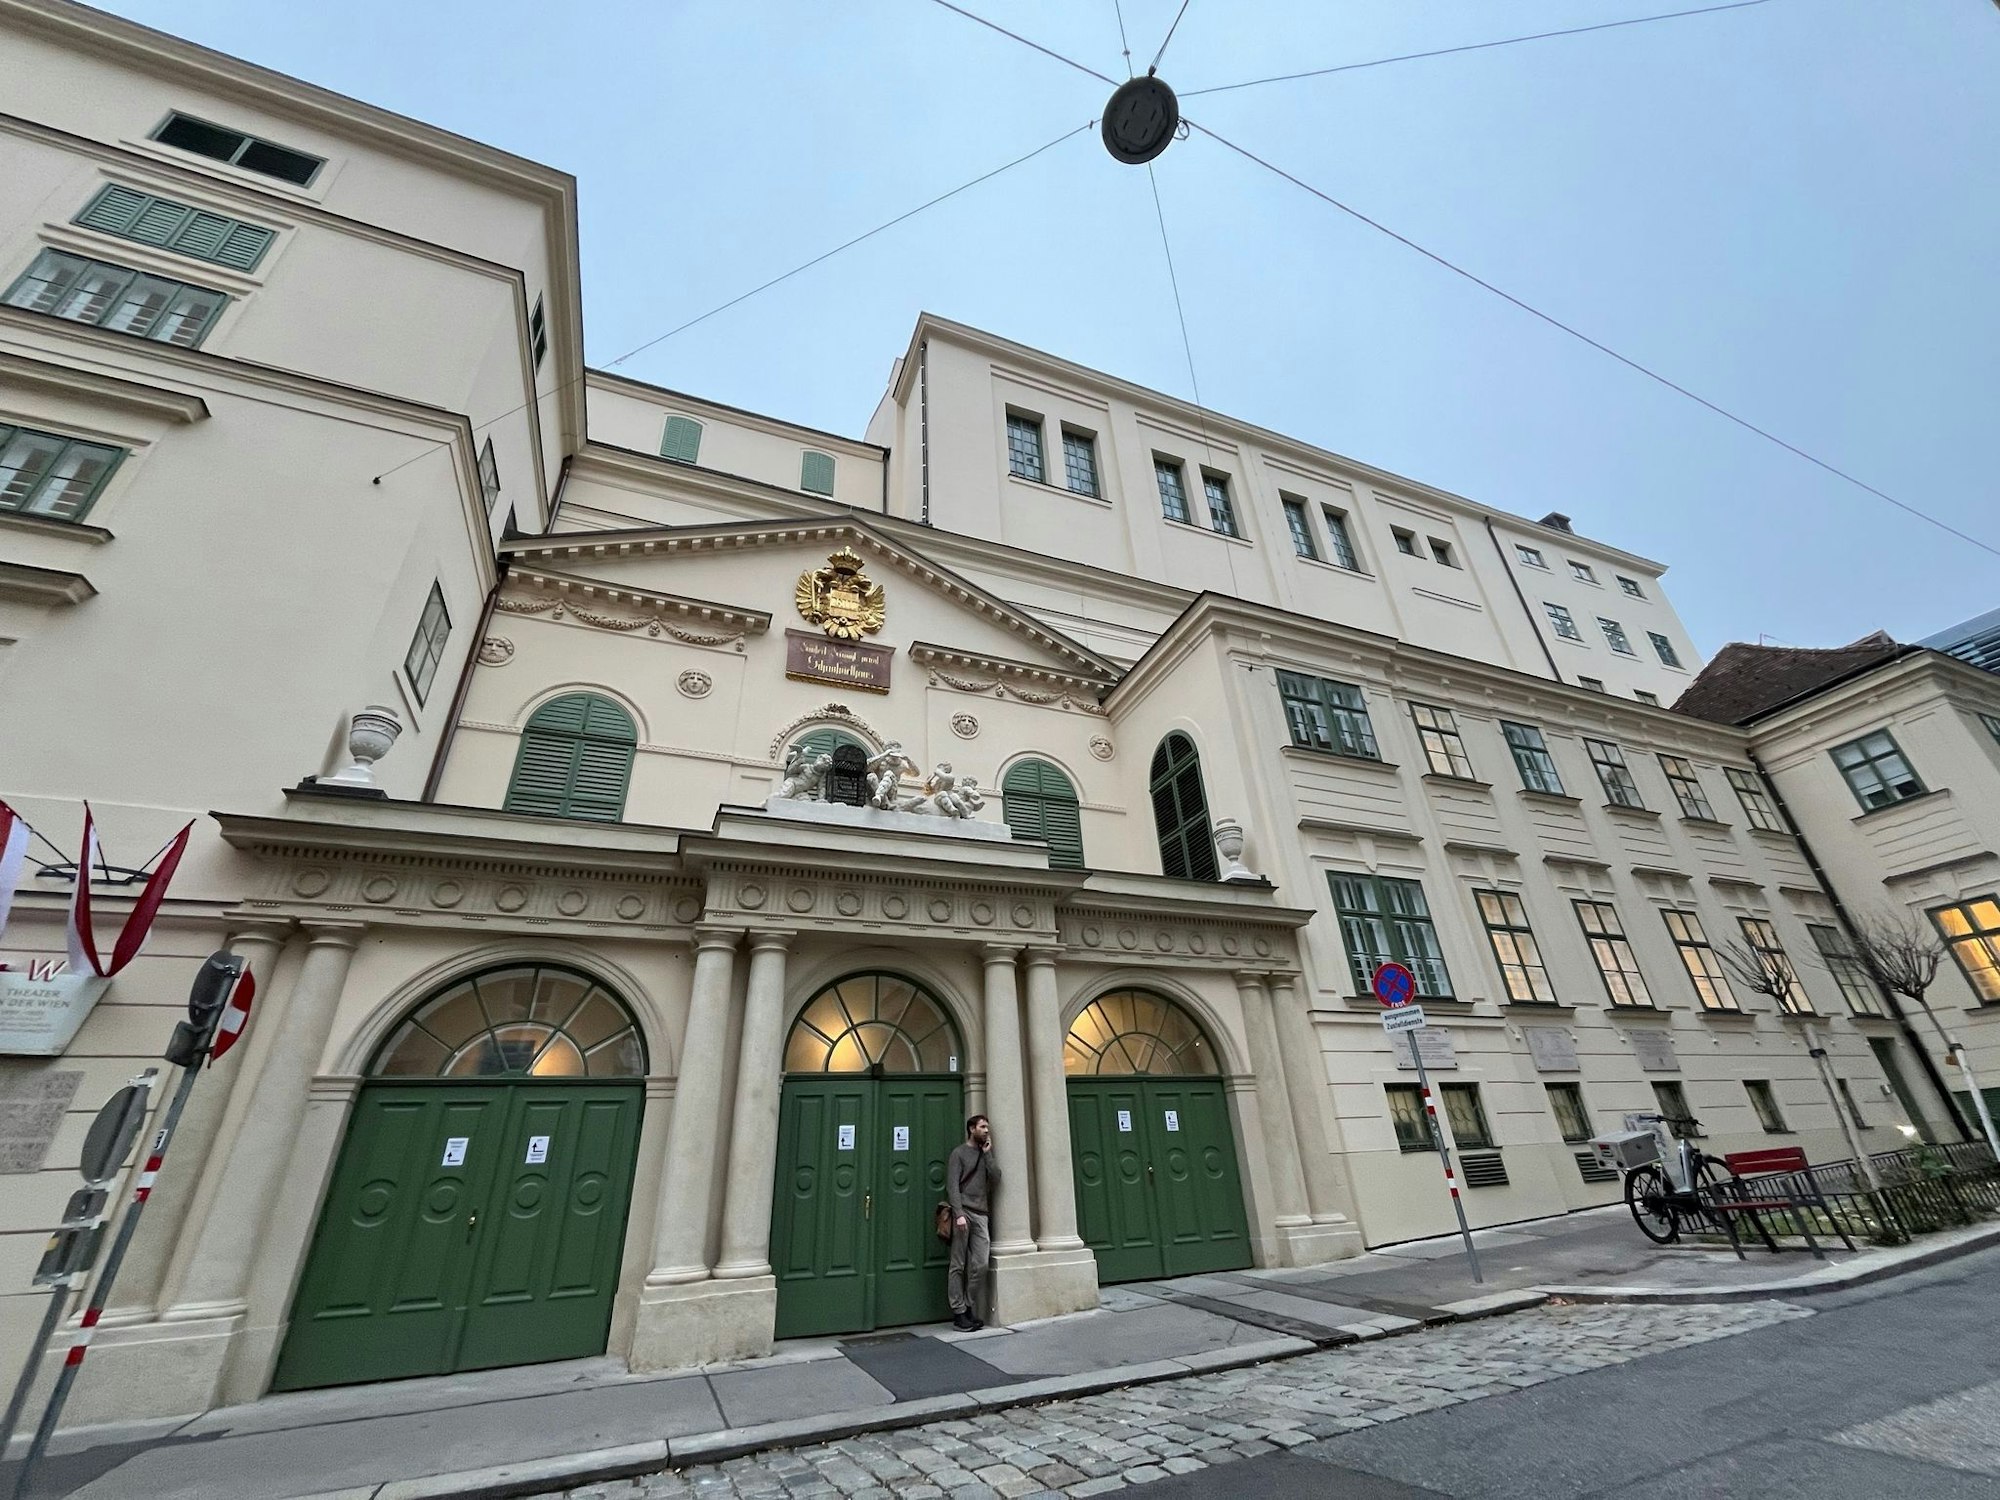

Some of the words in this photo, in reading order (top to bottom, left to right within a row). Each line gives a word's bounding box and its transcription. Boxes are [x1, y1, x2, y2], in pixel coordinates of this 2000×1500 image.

[28, 959, 69, 982] W
[8, 988, 61, 998] THEATER
[7, 999, 34, 1008] DER
[38, 1000, 71, 1009] WIEN
